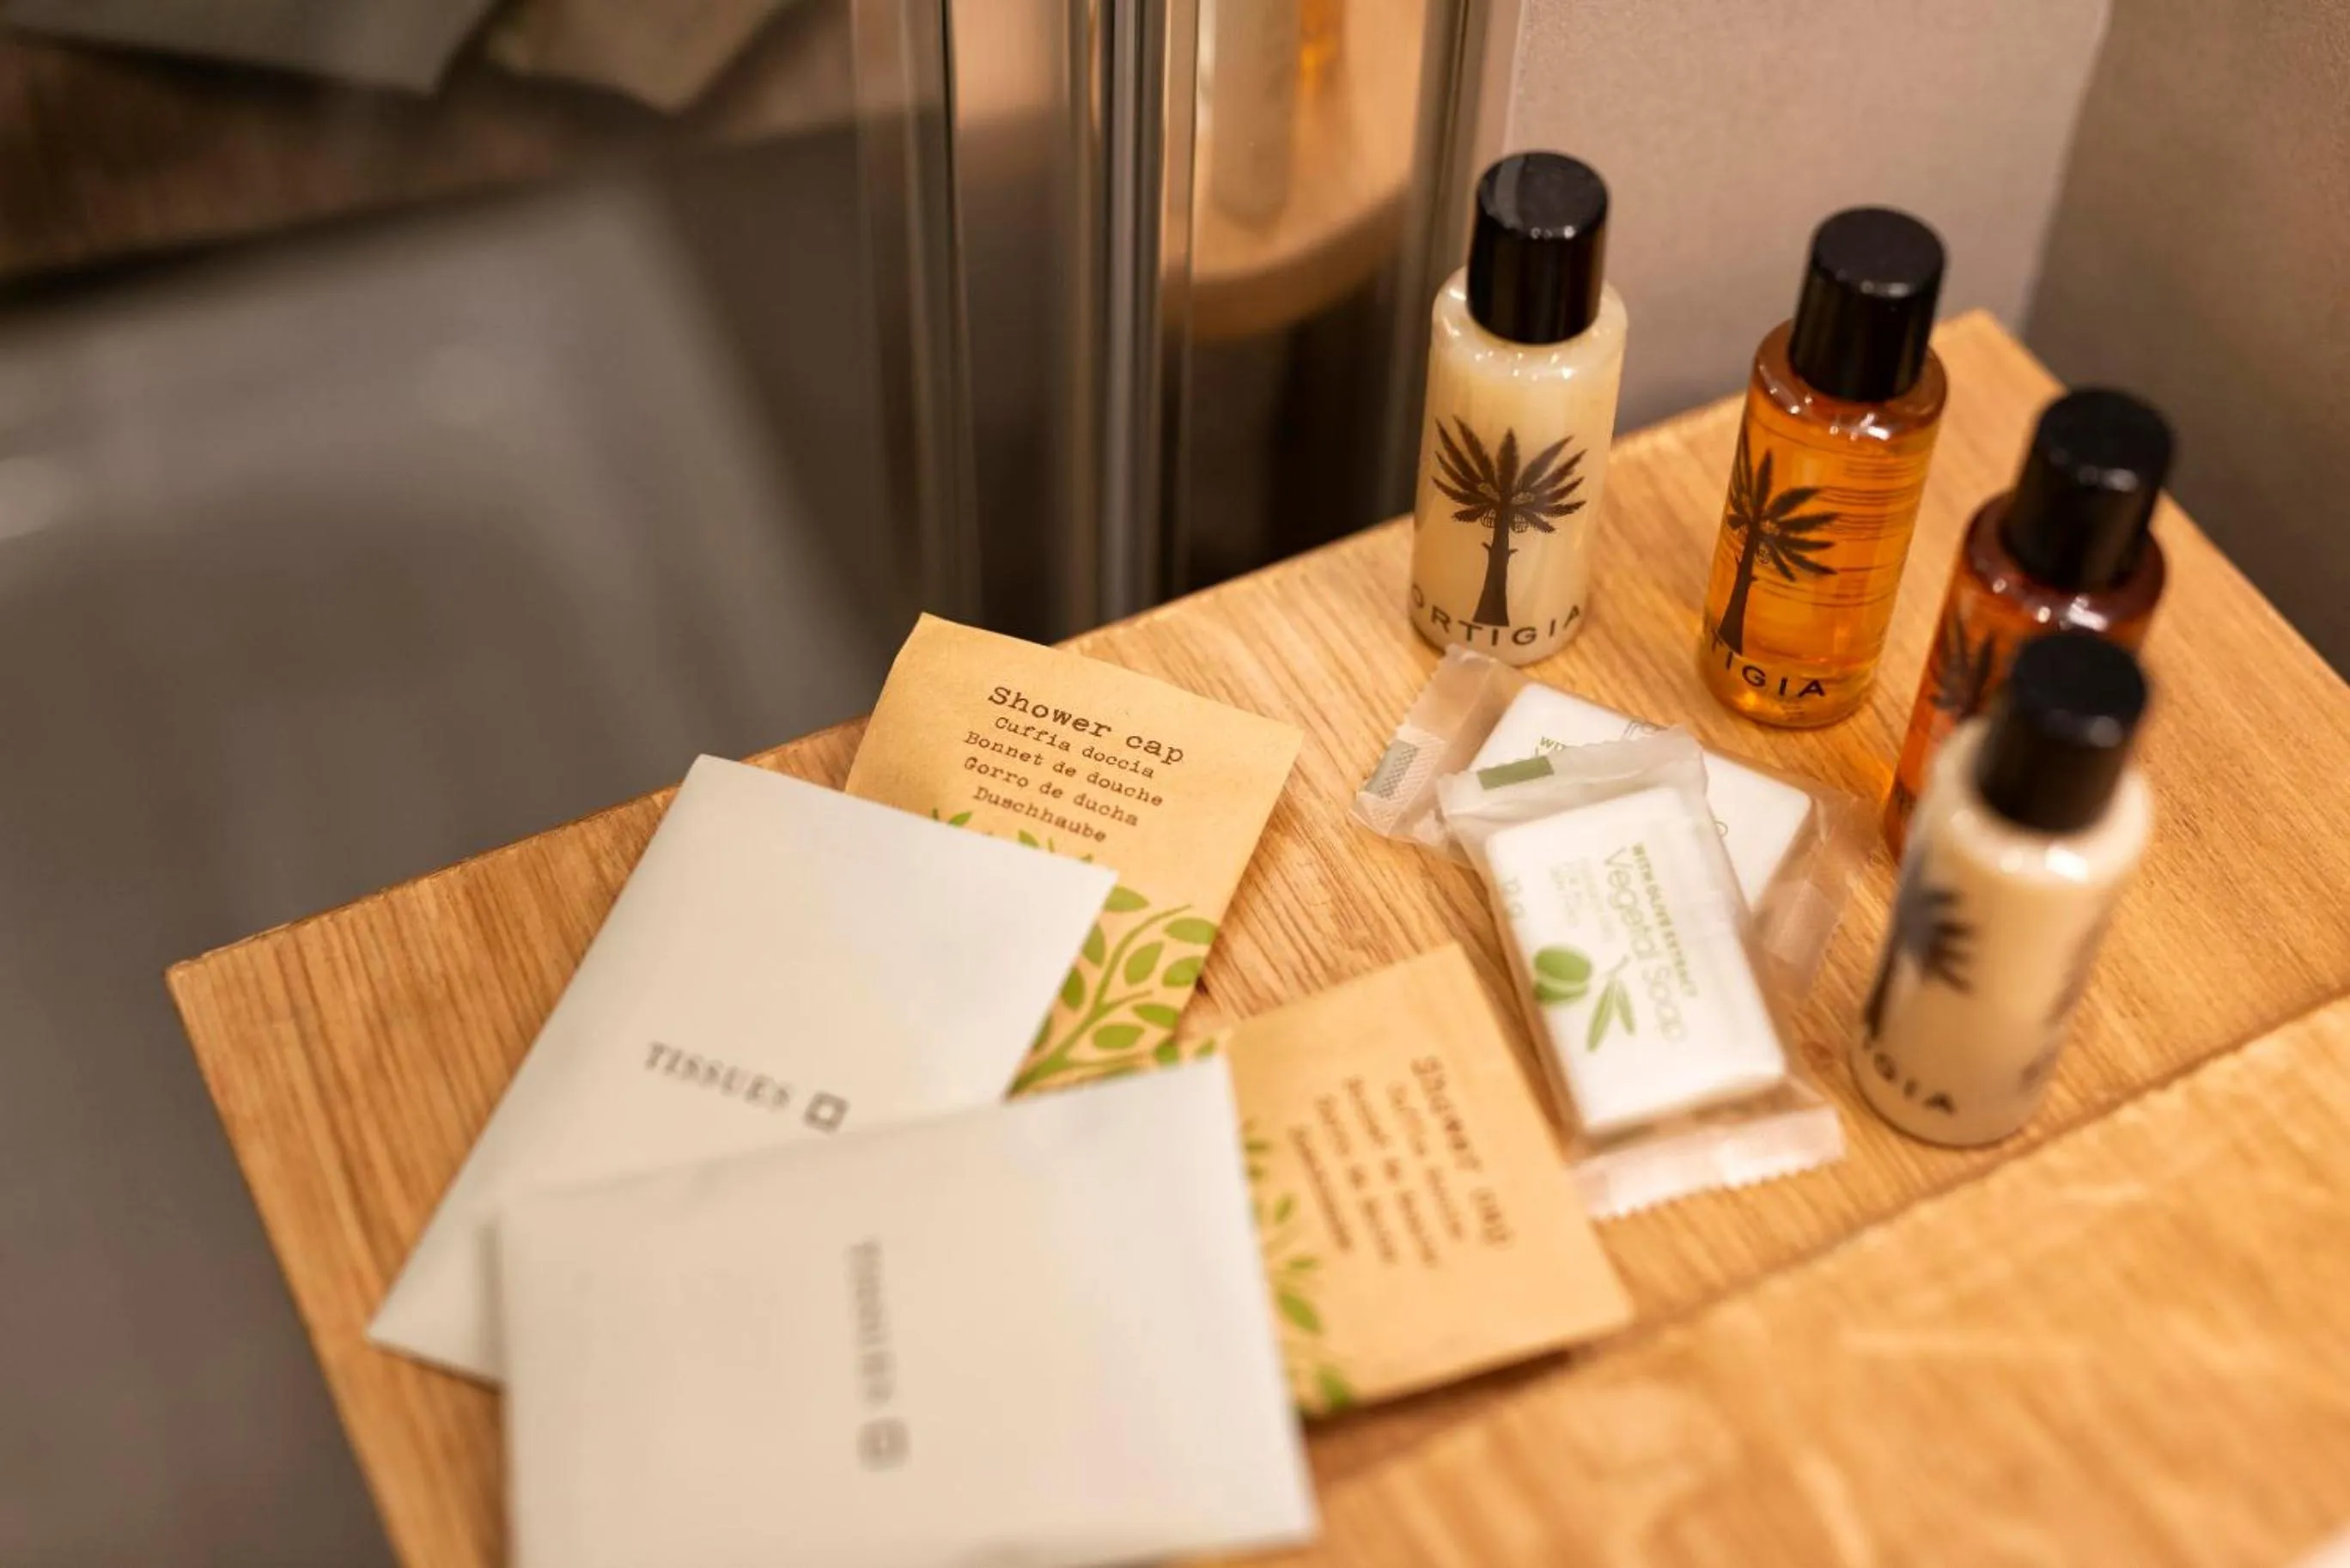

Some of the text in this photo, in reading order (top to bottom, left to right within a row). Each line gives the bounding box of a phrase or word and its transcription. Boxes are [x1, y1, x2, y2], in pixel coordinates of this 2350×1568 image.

[1411, 583, 1580, 646] ORTIGIA
[1710, 628, 1826, 698] TIGIA
[988, 686, 1184, 765] Shower cap
[995, 716, 1154, 779] Cuffia doccia
[963, 731, 1163, 807] Bonnet de douche
[964, 756, 1139, 827] Gorro de ducha
[973, 786, 1107, 842] Duschhaube
[1604, 845, 1689, 1042] Vegetal Soap
